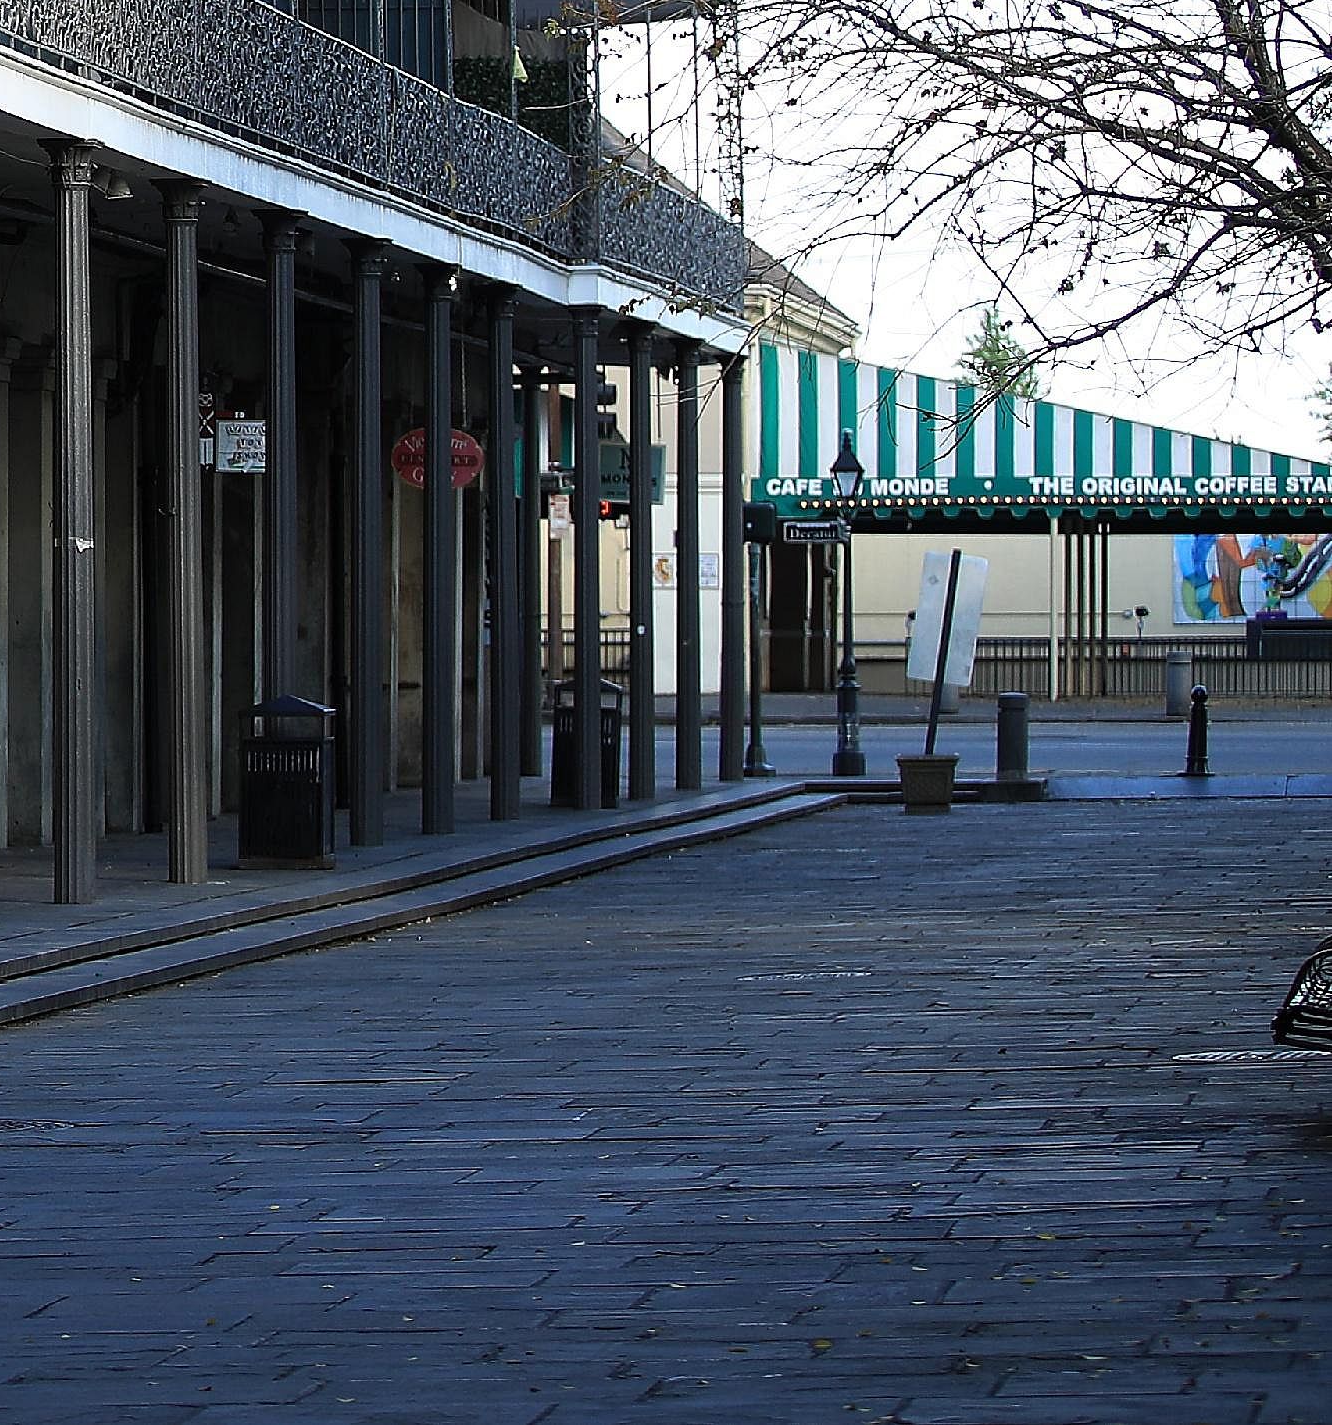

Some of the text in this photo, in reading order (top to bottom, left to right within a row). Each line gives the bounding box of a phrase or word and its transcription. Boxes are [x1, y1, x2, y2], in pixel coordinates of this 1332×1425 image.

[765, 478, 823, 496] CAFE
[870, 478, 949, 496] MONDE
[1029, 477, 1075, 496] THE
[1082, 477, 1187, 496] ORIGINAL
[1194, 477, 1277, 495] COFFEE
